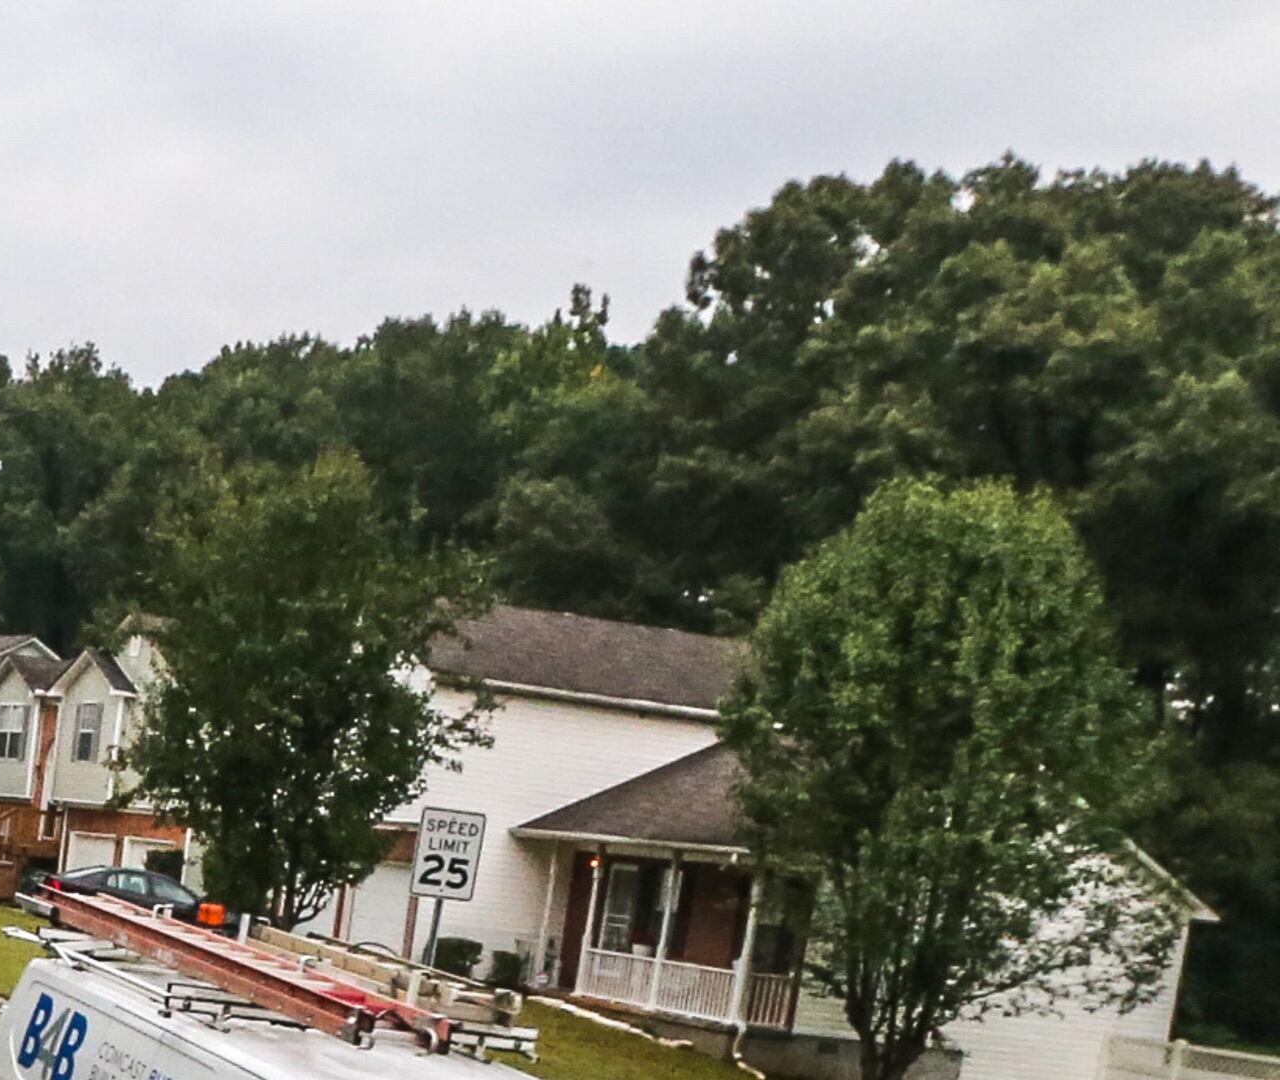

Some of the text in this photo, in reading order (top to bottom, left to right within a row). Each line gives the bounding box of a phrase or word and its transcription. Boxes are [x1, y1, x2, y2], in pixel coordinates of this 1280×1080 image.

[426, 818, 479, 837] SPEED
[428, 837, 471, 854] LIMIT
[418, 853, 469, 889] 25
[98, 1041, 148, 1080] COMCAST
